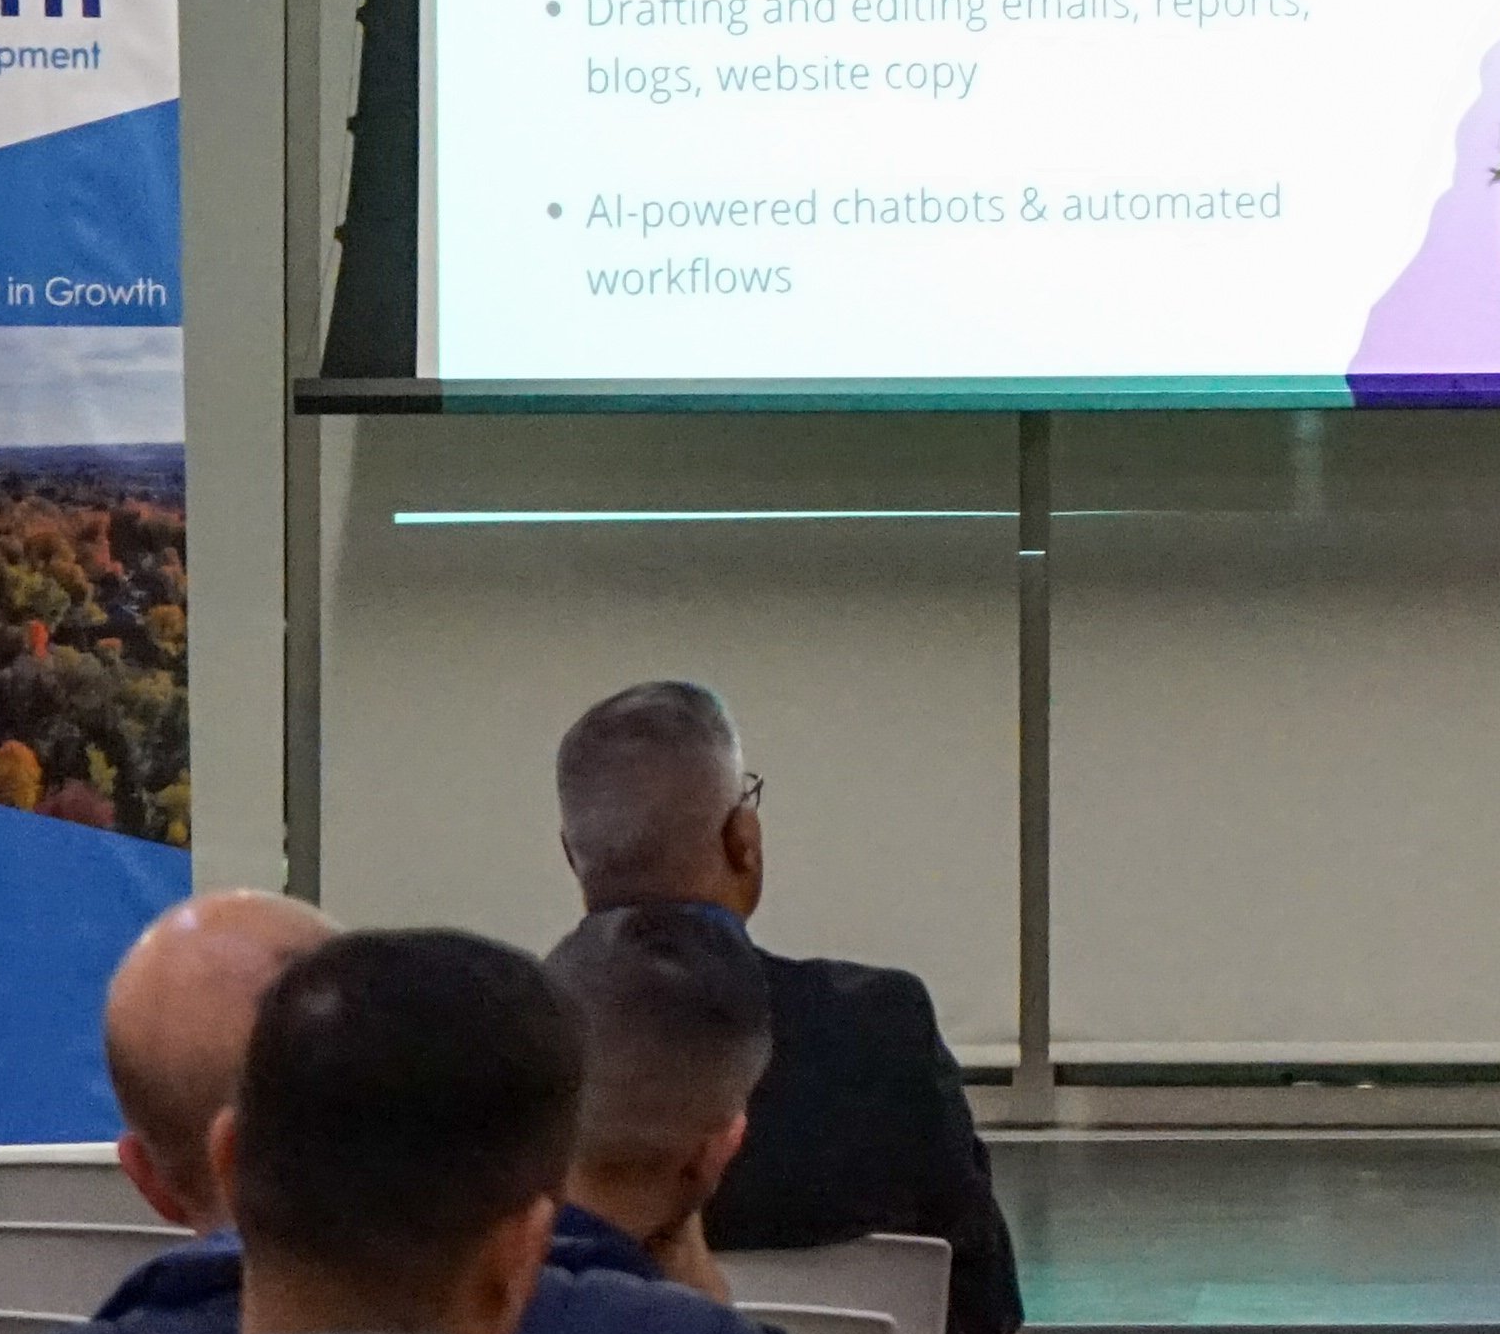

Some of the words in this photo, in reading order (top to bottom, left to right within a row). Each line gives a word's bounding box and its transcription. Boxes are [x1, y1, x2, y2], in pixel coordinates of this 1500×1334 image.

[587, 57, 701, 104] blogs,
[716, 55, 870, 91] website
[885, 62, 978, 100] copy
[586, 190, 816, 233] AI-powered
[833, 188, 1005, 225] chatbots
[1020, 186, 1047, 222] &
[1062, 183, 1281, 221] automated
[8, 277, 34, 304] in
[45, 276, 166, 306] Growth
[587, 257, 792, 296] workflows
